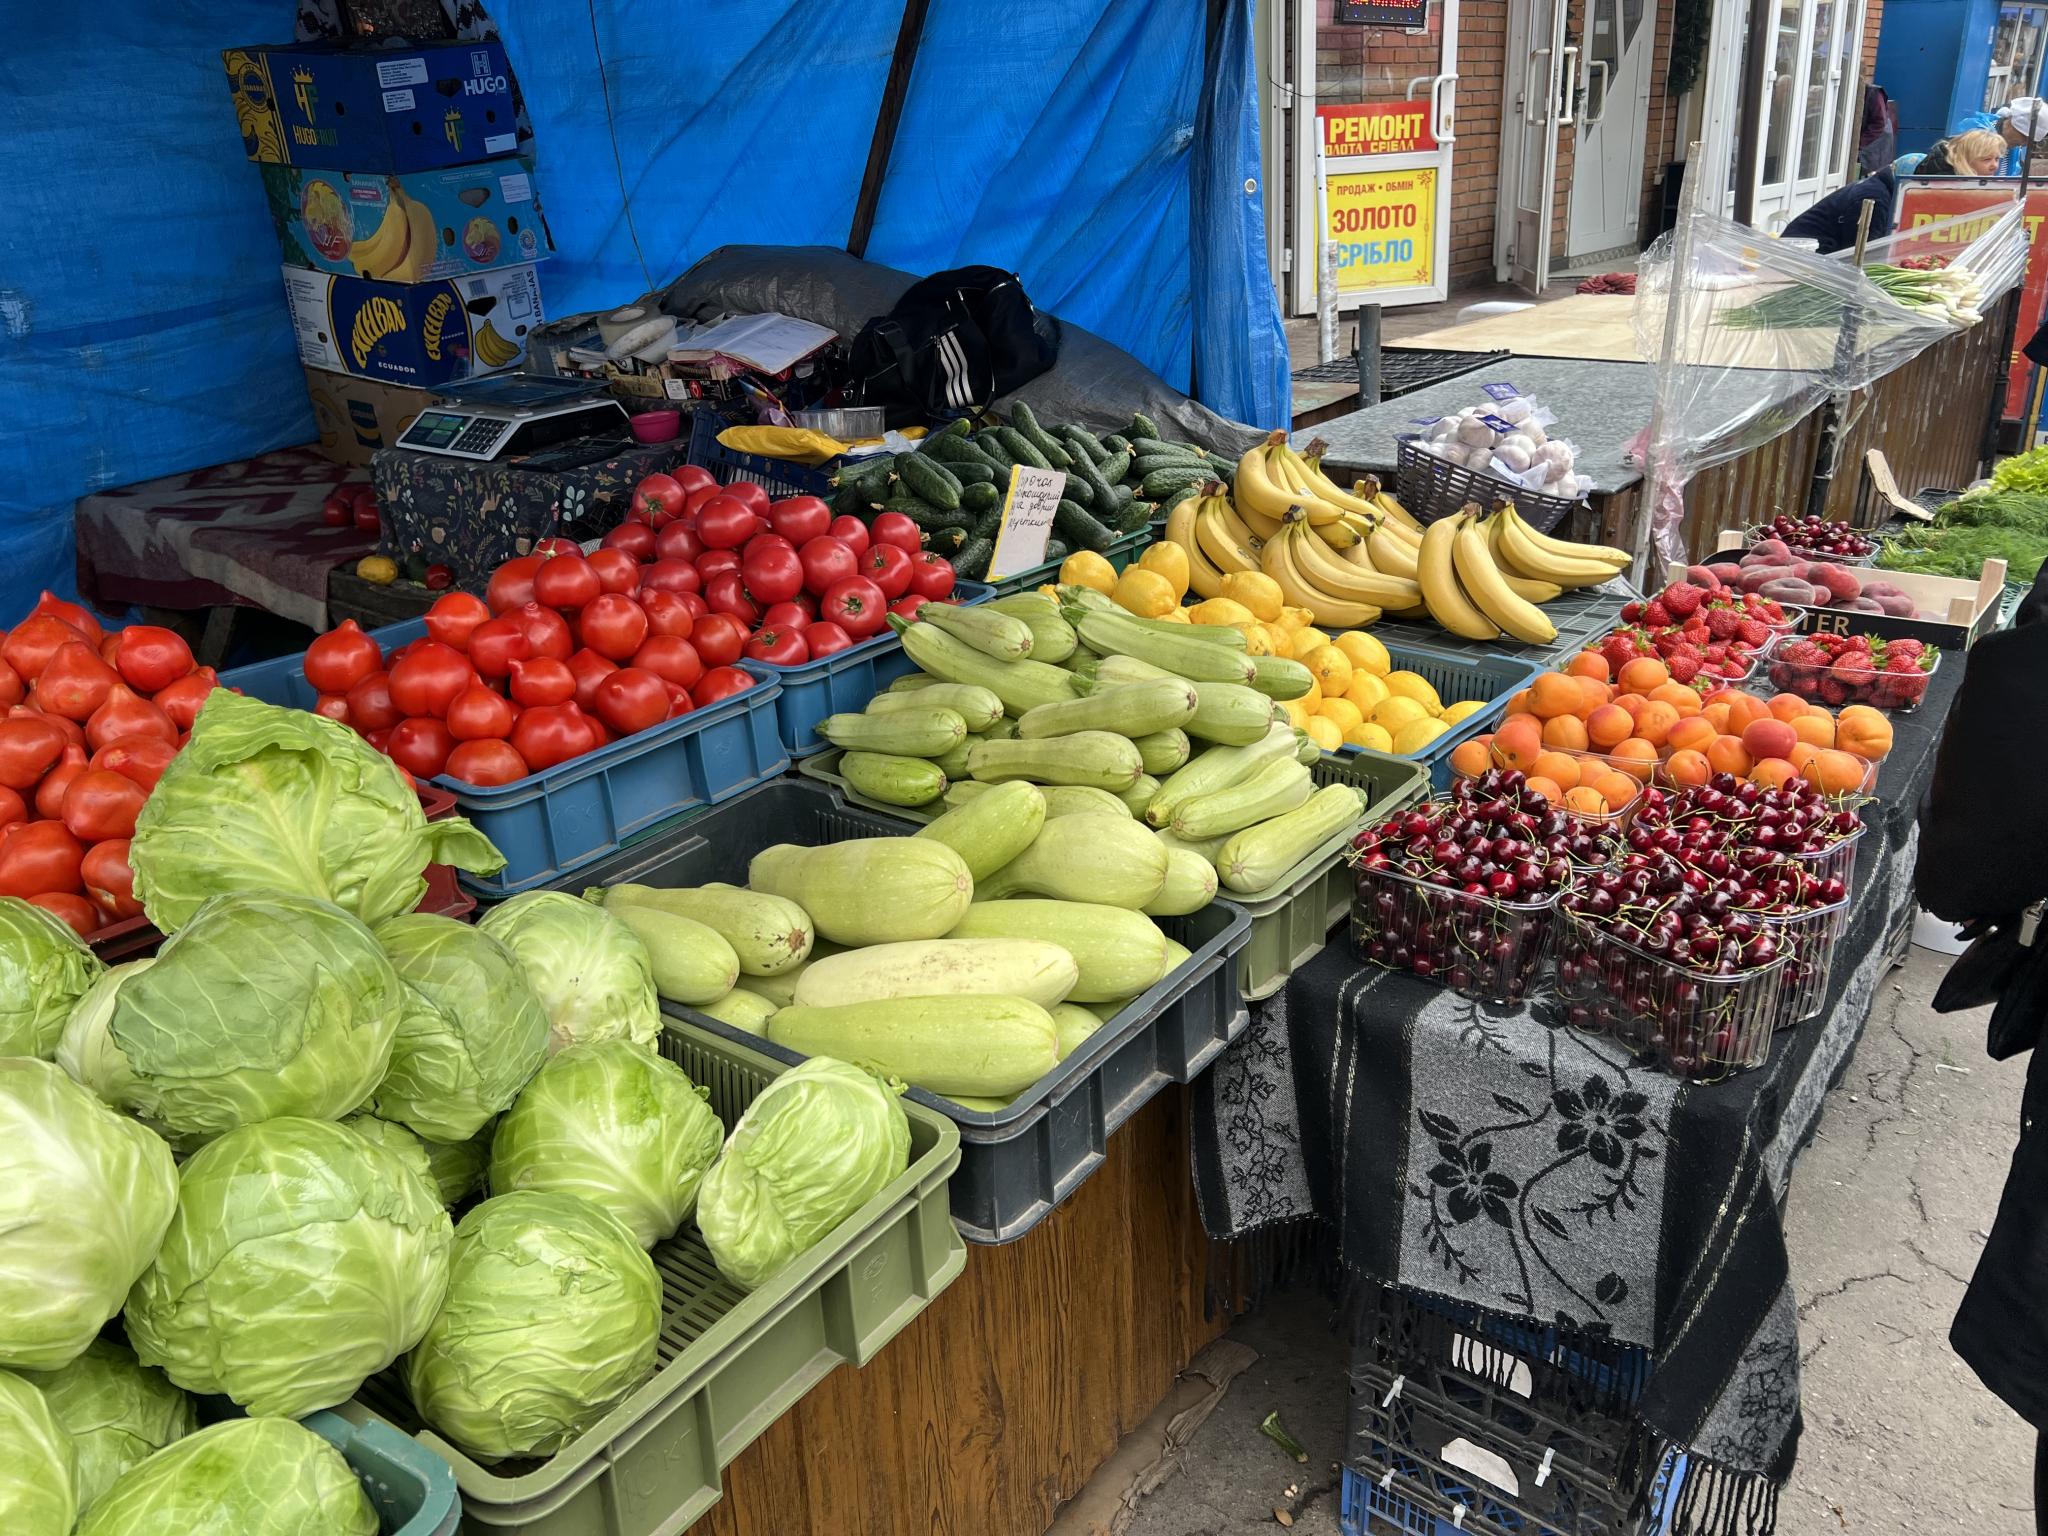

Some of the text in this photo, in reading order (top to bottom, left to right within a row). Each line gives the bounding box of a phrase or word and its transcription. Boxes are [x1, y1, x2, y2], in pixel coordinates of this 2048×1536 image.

[464, 76, 507, 96] HUGO
[1329, 113, 1425, 144] РЕМОНТ
[1325, 143, 1363, 156] ОЛОТА
[1336, 180, 1414, 196] ПРОДАЖ ОБМІН
[1332, 203, 1417, 233] ЗОЛОТО
[1910, 213, 2045, 245] РЕМТ
[1337, 238, 1413, 268] СРІБЛО
[378, 361, 416, 374] ECUADOR
[1786, 610, 1850, 636] TER
